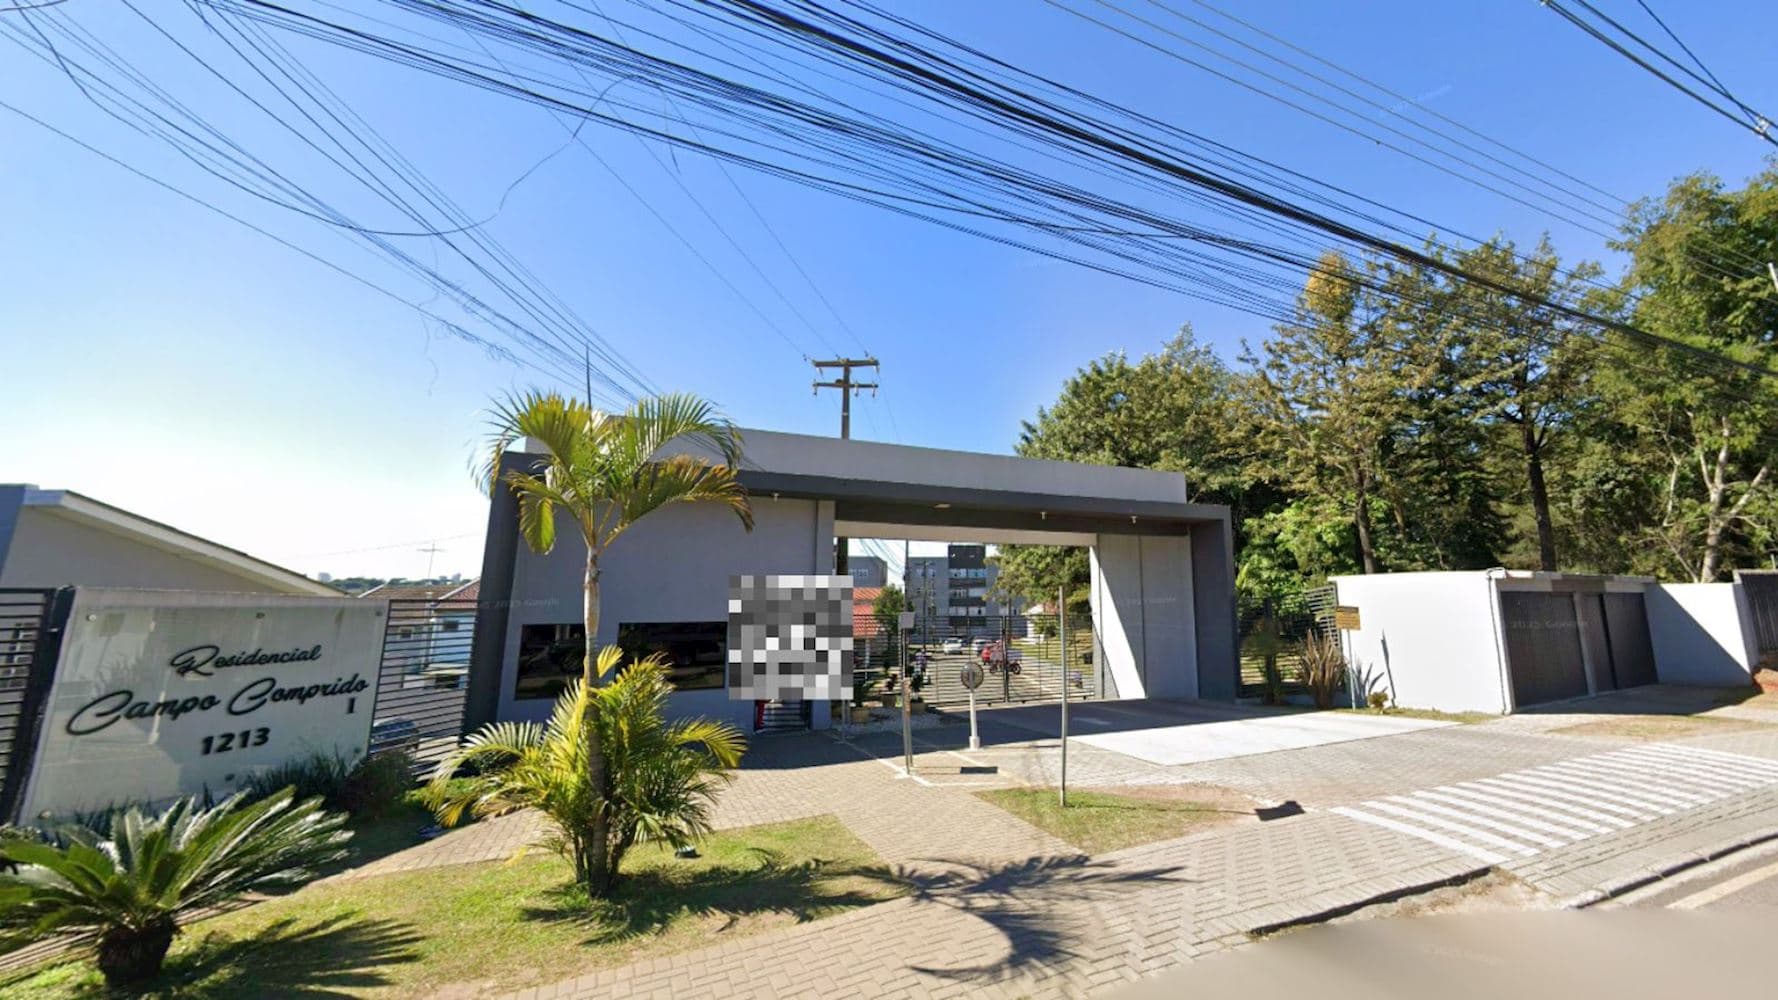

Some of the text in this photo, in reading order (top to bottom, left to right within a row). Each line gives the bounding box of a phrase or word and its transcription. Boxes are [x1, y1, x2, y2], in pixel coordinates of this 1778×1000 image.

[169, 644, 322, 677] Residencial
[65, 672, 369, 736] Campo Comprido
[201, 726, 271, 756] 1213
